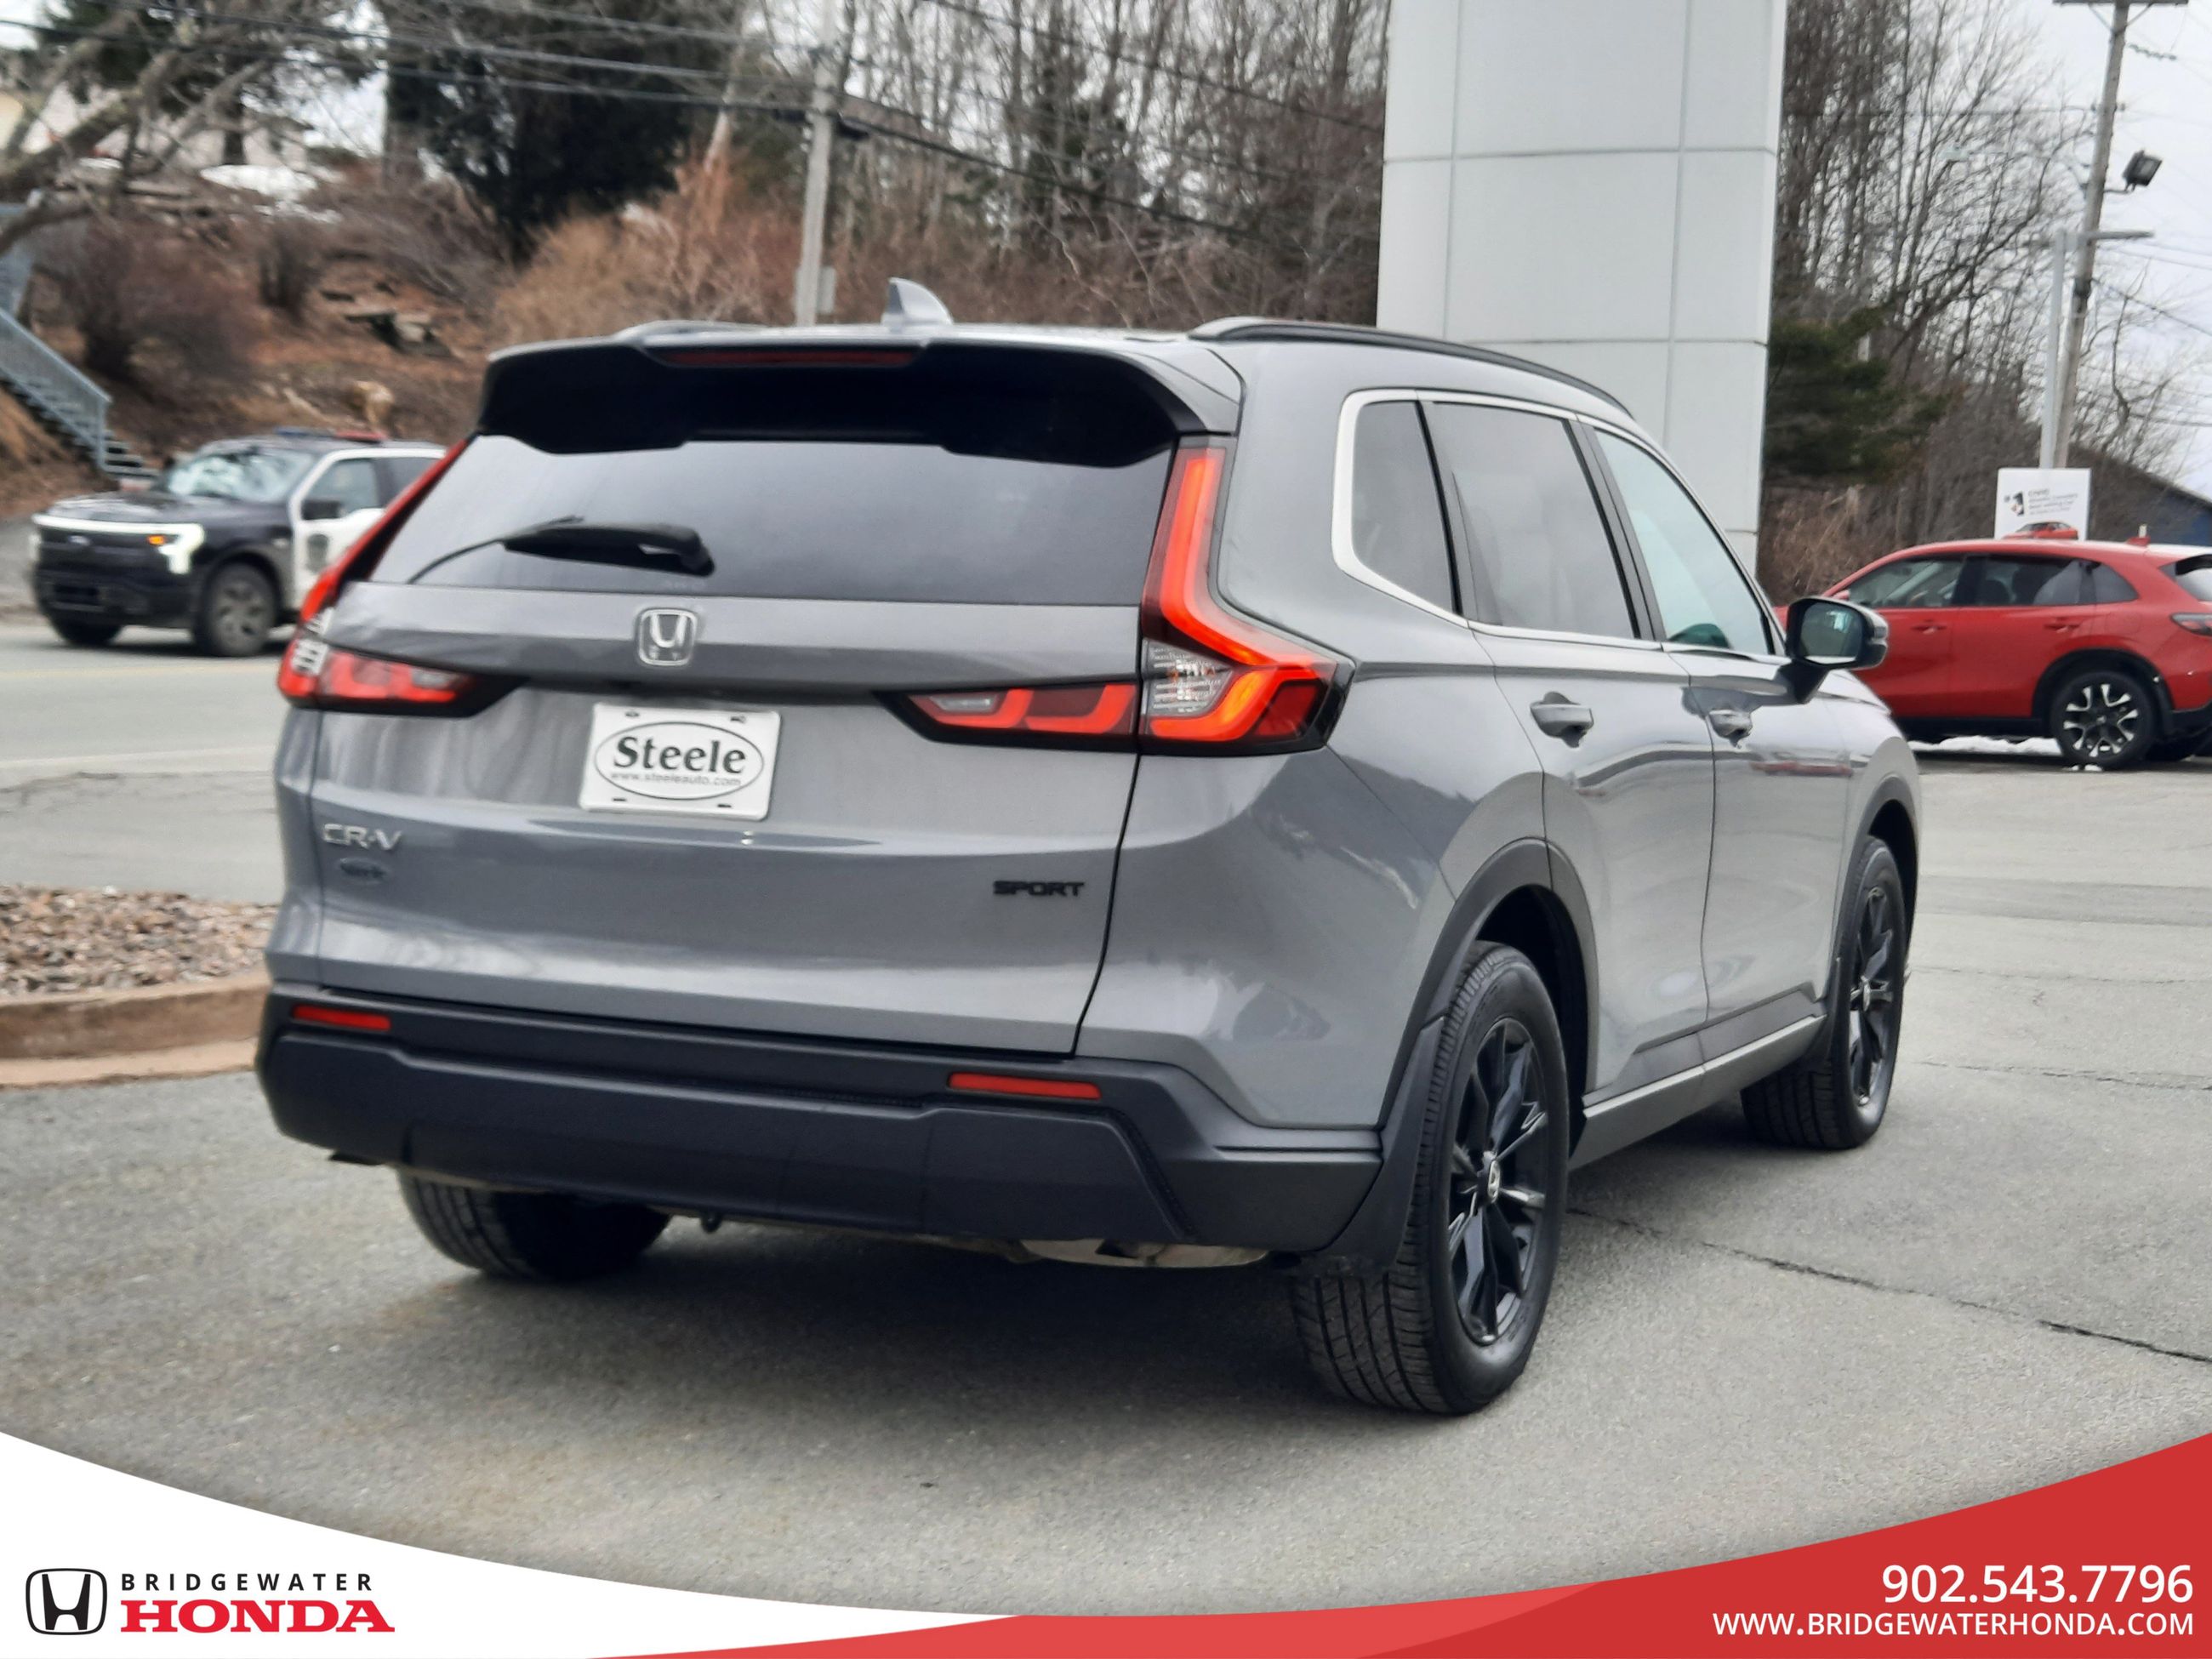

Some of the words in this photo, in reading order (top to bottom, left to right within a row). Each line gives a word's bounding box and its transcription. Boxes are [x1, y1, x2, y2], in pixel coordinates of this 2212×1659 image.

[613, 736, 746, 774] Steele
[610, 772, 742, 787] www.steeleauto.com
[323, 823, 402, 850] CR-V
[993, 880, 1085, 897] SPORT
